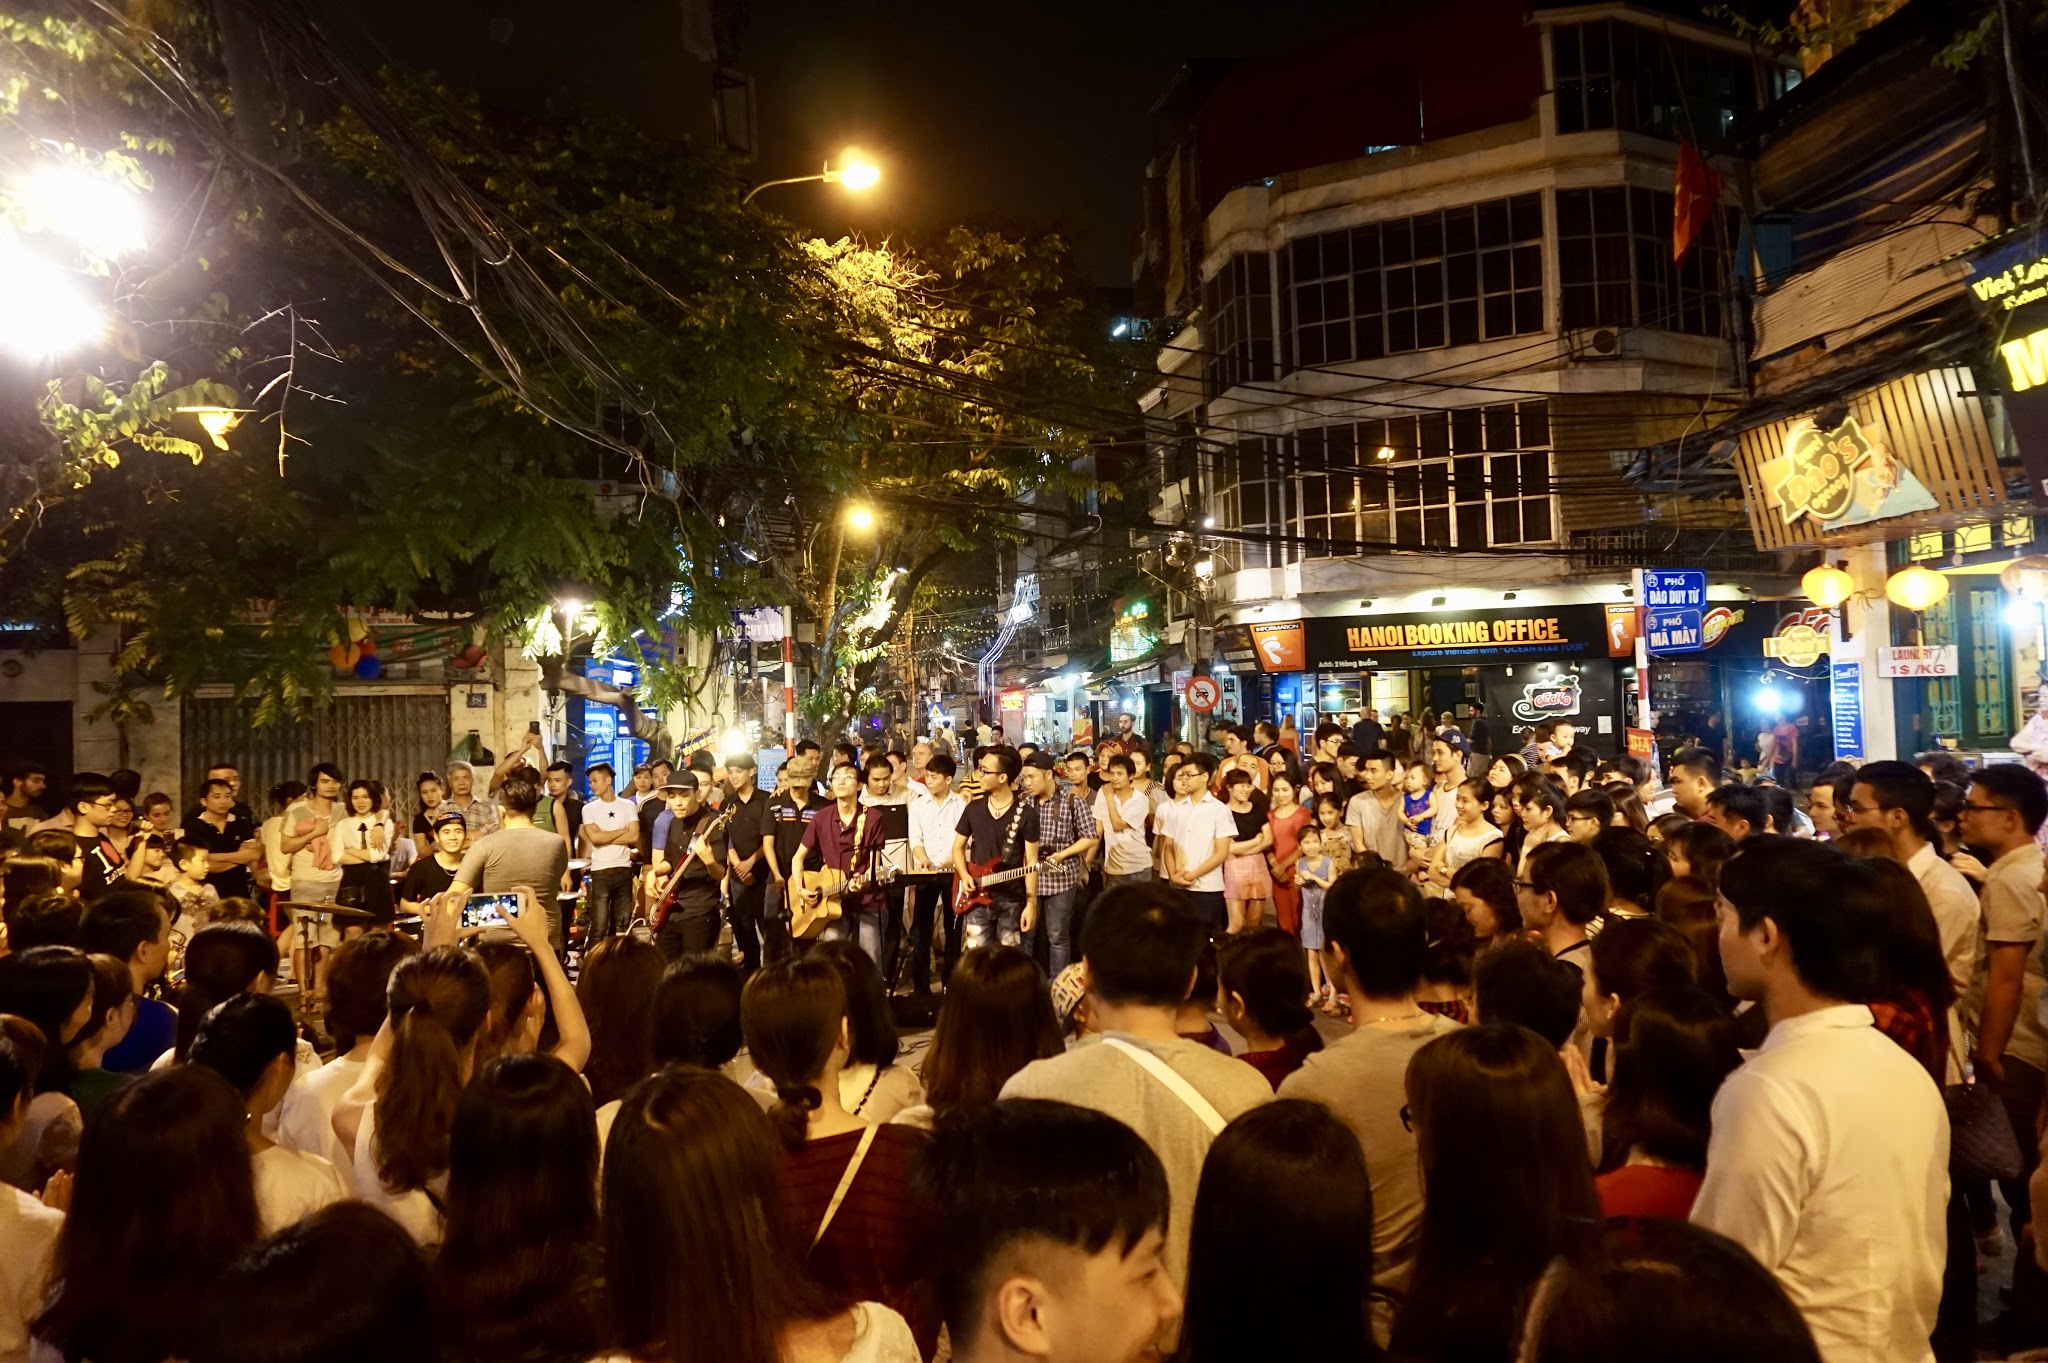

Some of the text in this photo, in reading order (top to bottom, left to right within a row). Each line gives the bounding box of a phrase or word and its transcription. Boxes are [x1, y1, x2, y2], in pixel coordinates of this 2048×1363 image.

[1664, 574, 1686, 586] PHỐ
[1649, 586, 1700, 605] ĐÀO DUY TỪ
[1255, 624, 1299, 632] INFORMATION
[1663, 614, 1682, 627] PHỐ
[1346, 618, 1560, 648] HANOI BOOKING OFFICE
[1650, 626, 1698, 648] MÃ MÂY
[1412, 649, 1443, 658] Explore
[1445, 647, 1478, 656] Vietnam
[1479, 646, 1498, 655] with
[1628, 734, 1650, 753] BIA
[90, 846, 114, 875] I
